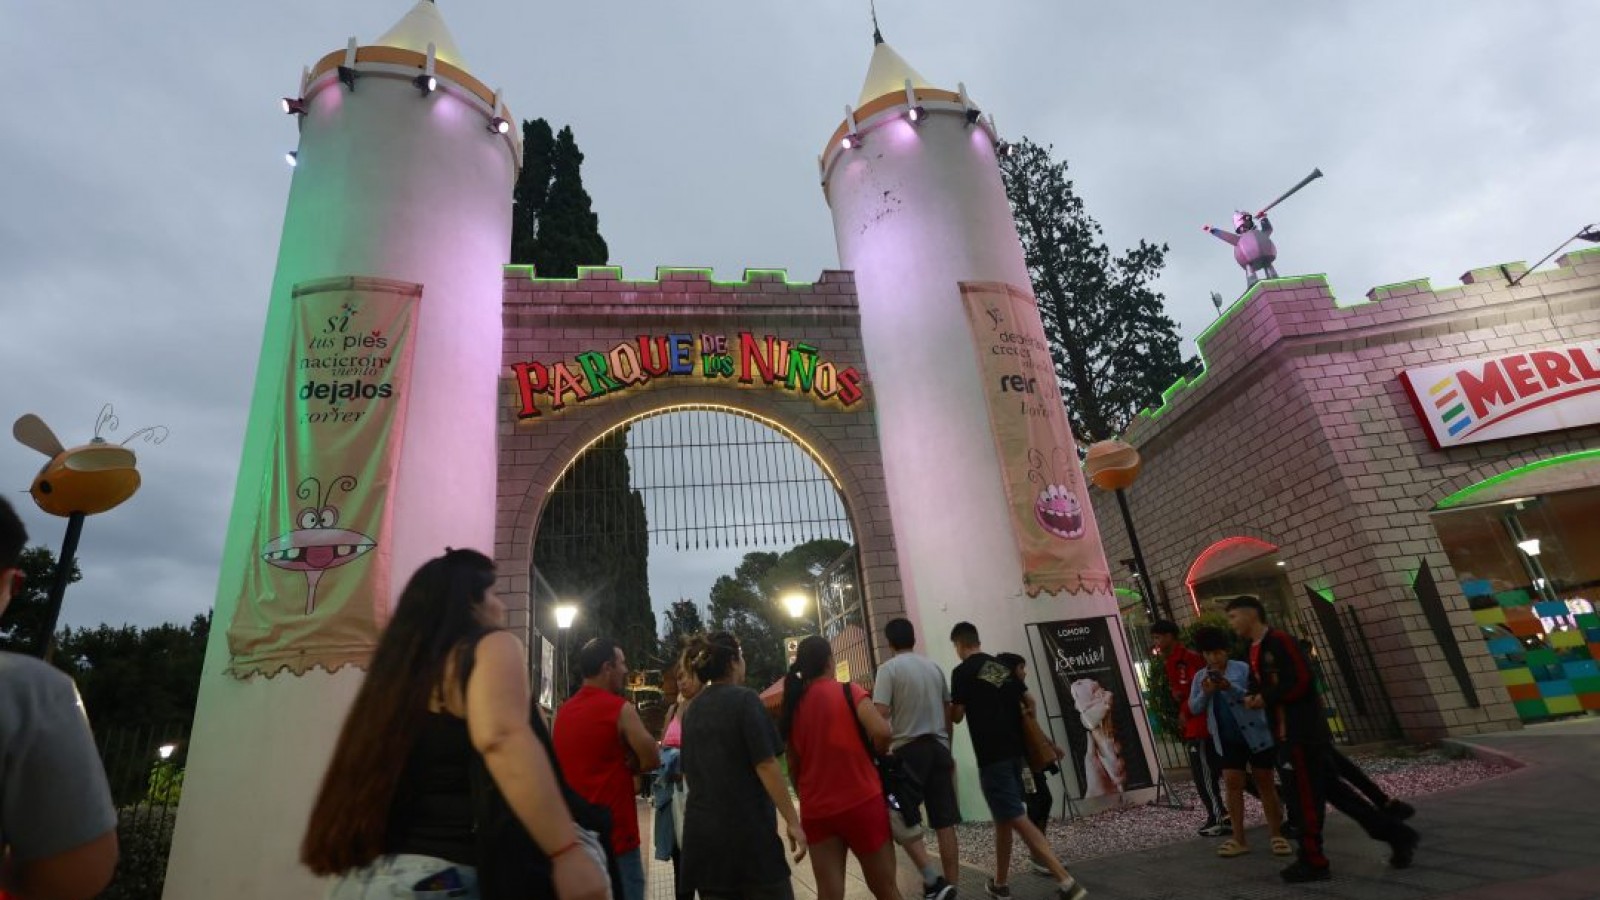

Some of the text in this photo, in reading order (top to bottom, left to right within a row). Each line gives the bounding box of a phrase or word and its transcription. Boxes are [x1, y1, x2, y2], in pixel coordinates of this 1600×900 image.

[309, 332, 388, 351] tus pies
[300, 353, 387, 369] nacieron
[511, 331, 863, 419] PARQUE DE LOS NIÑOS
[1455, 347, 1600, 420] MERL
[299, 380, 393, 405] dejalos
[1057, 626, 1091, 637] LOMORO
